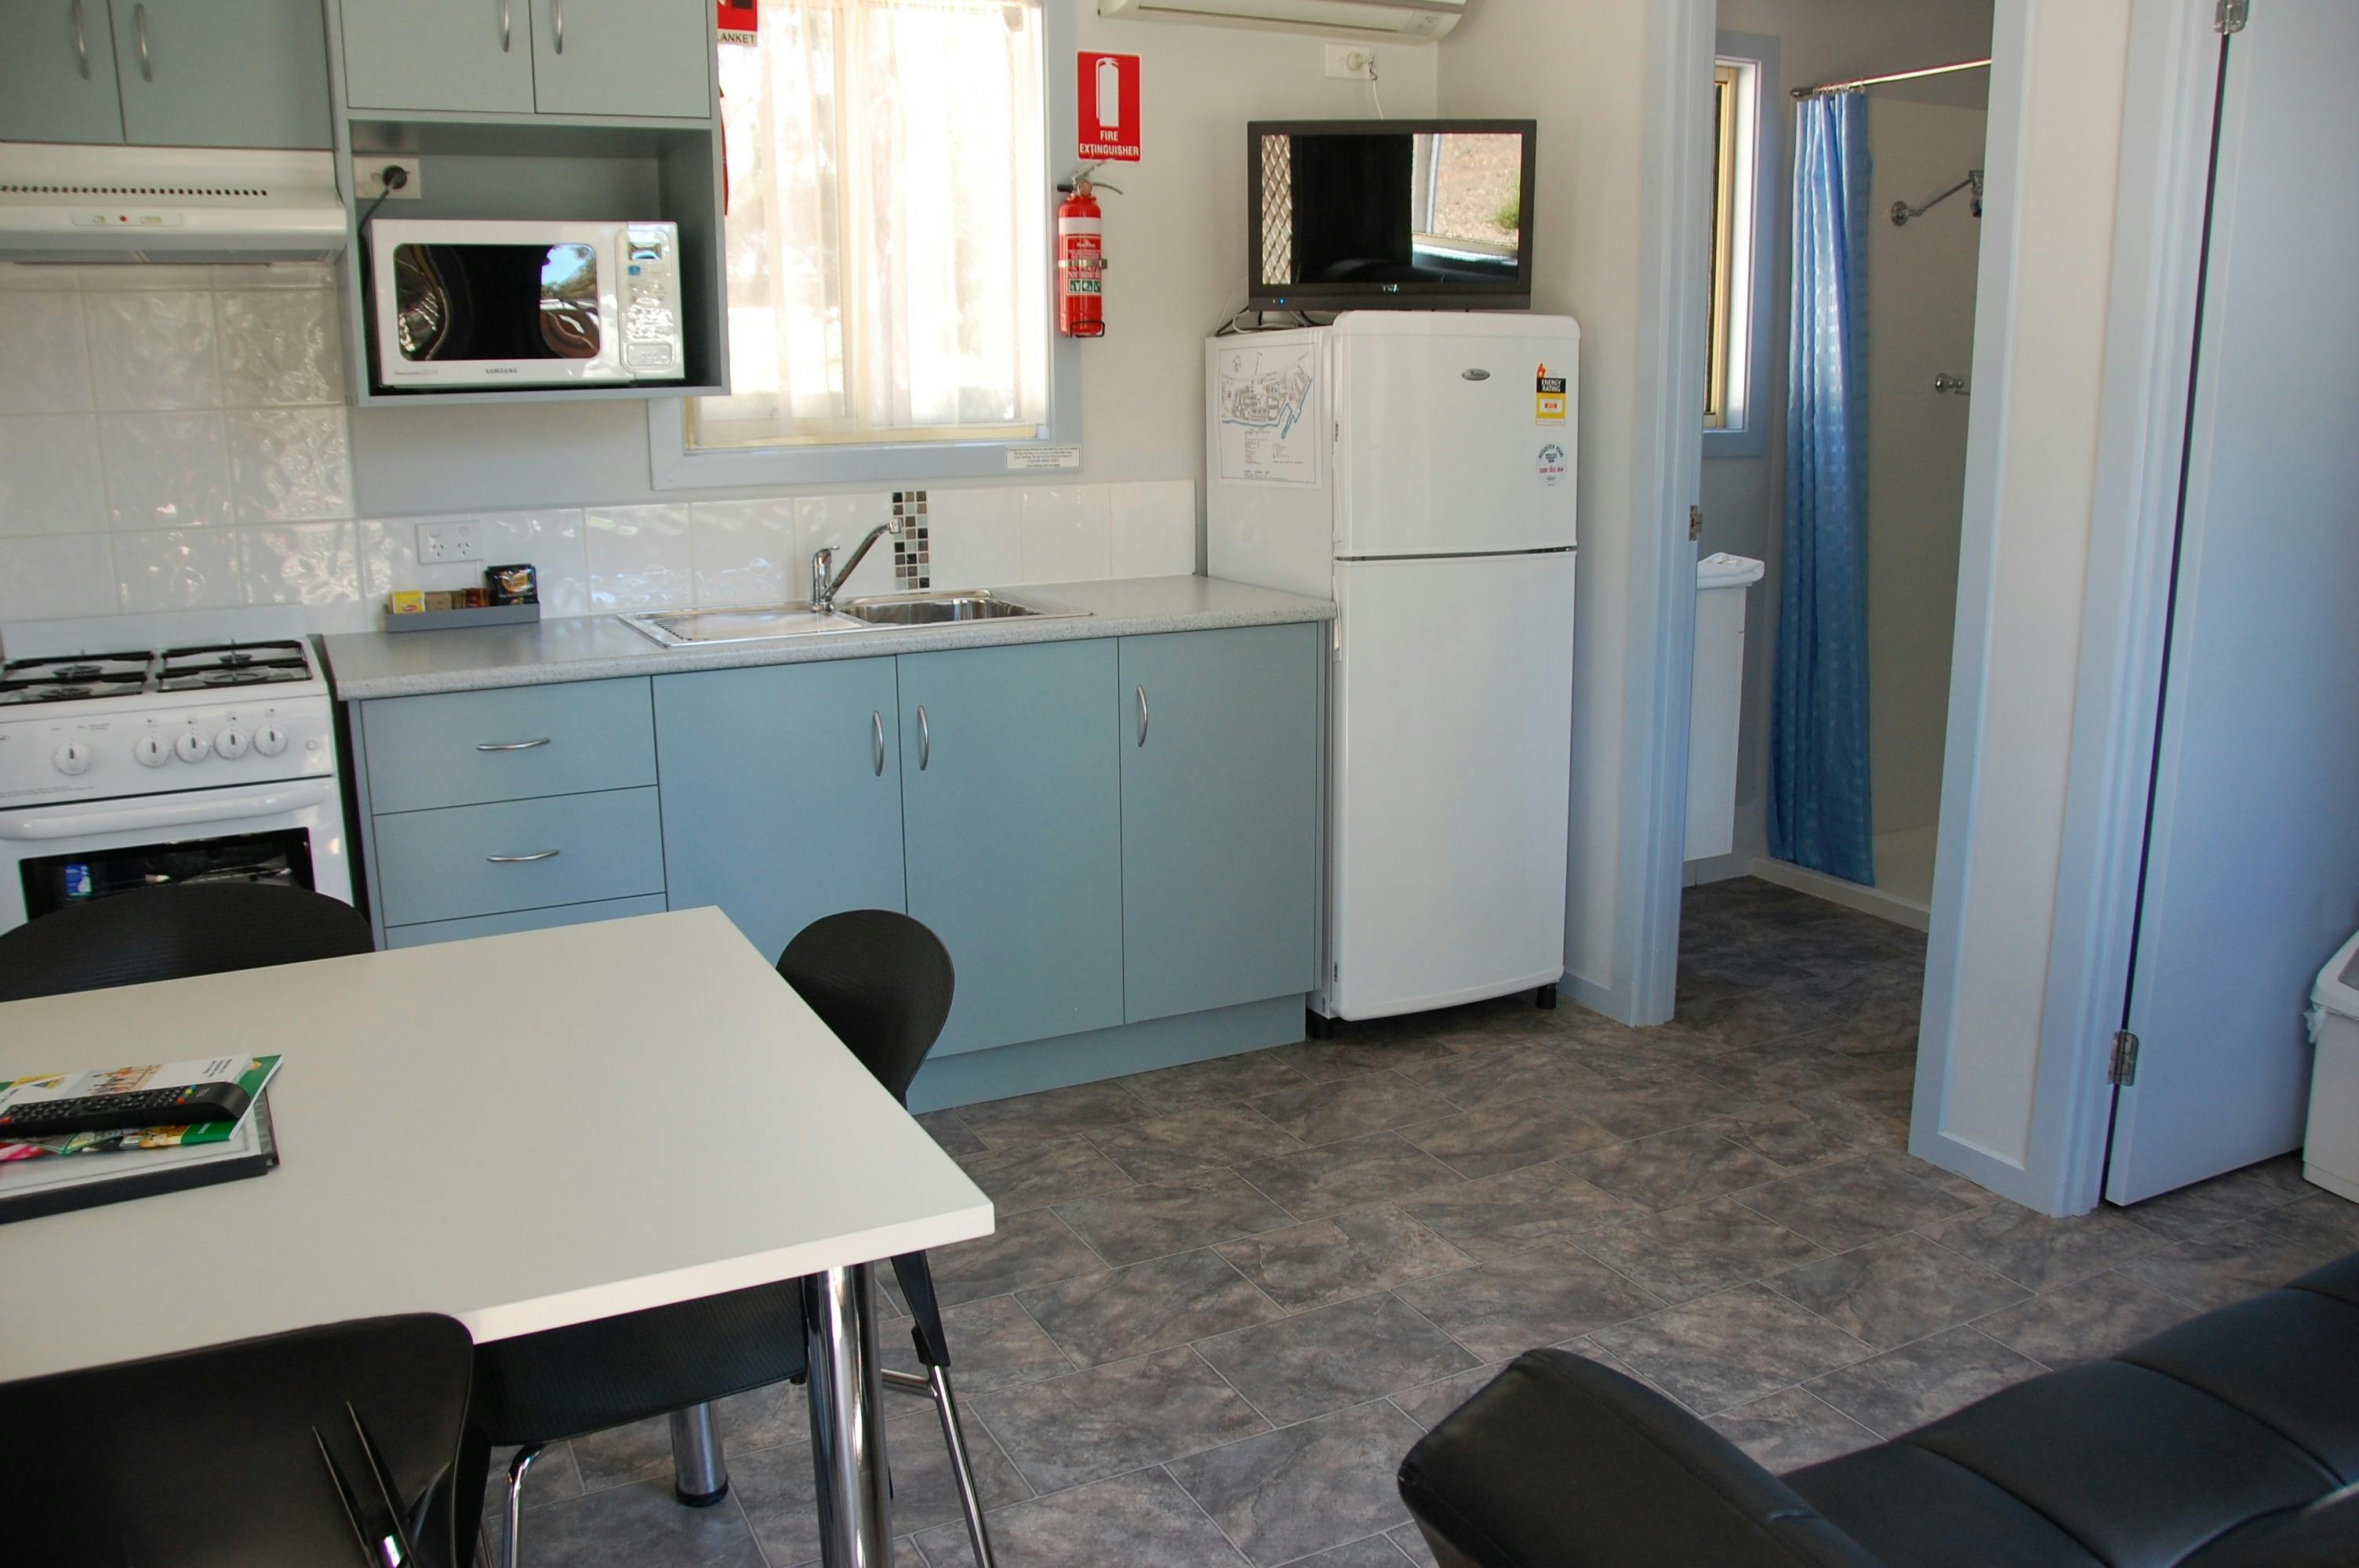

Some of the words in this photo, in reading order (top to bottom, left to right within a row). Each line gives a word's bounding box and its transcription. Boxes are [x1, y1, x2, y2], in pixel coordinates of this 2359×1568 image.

[718, 32, 755, 44] ANKET
[1100, 130, 1119, 142] FIRE
[1079, 143, 1140, 157] EXTINGUISHER
